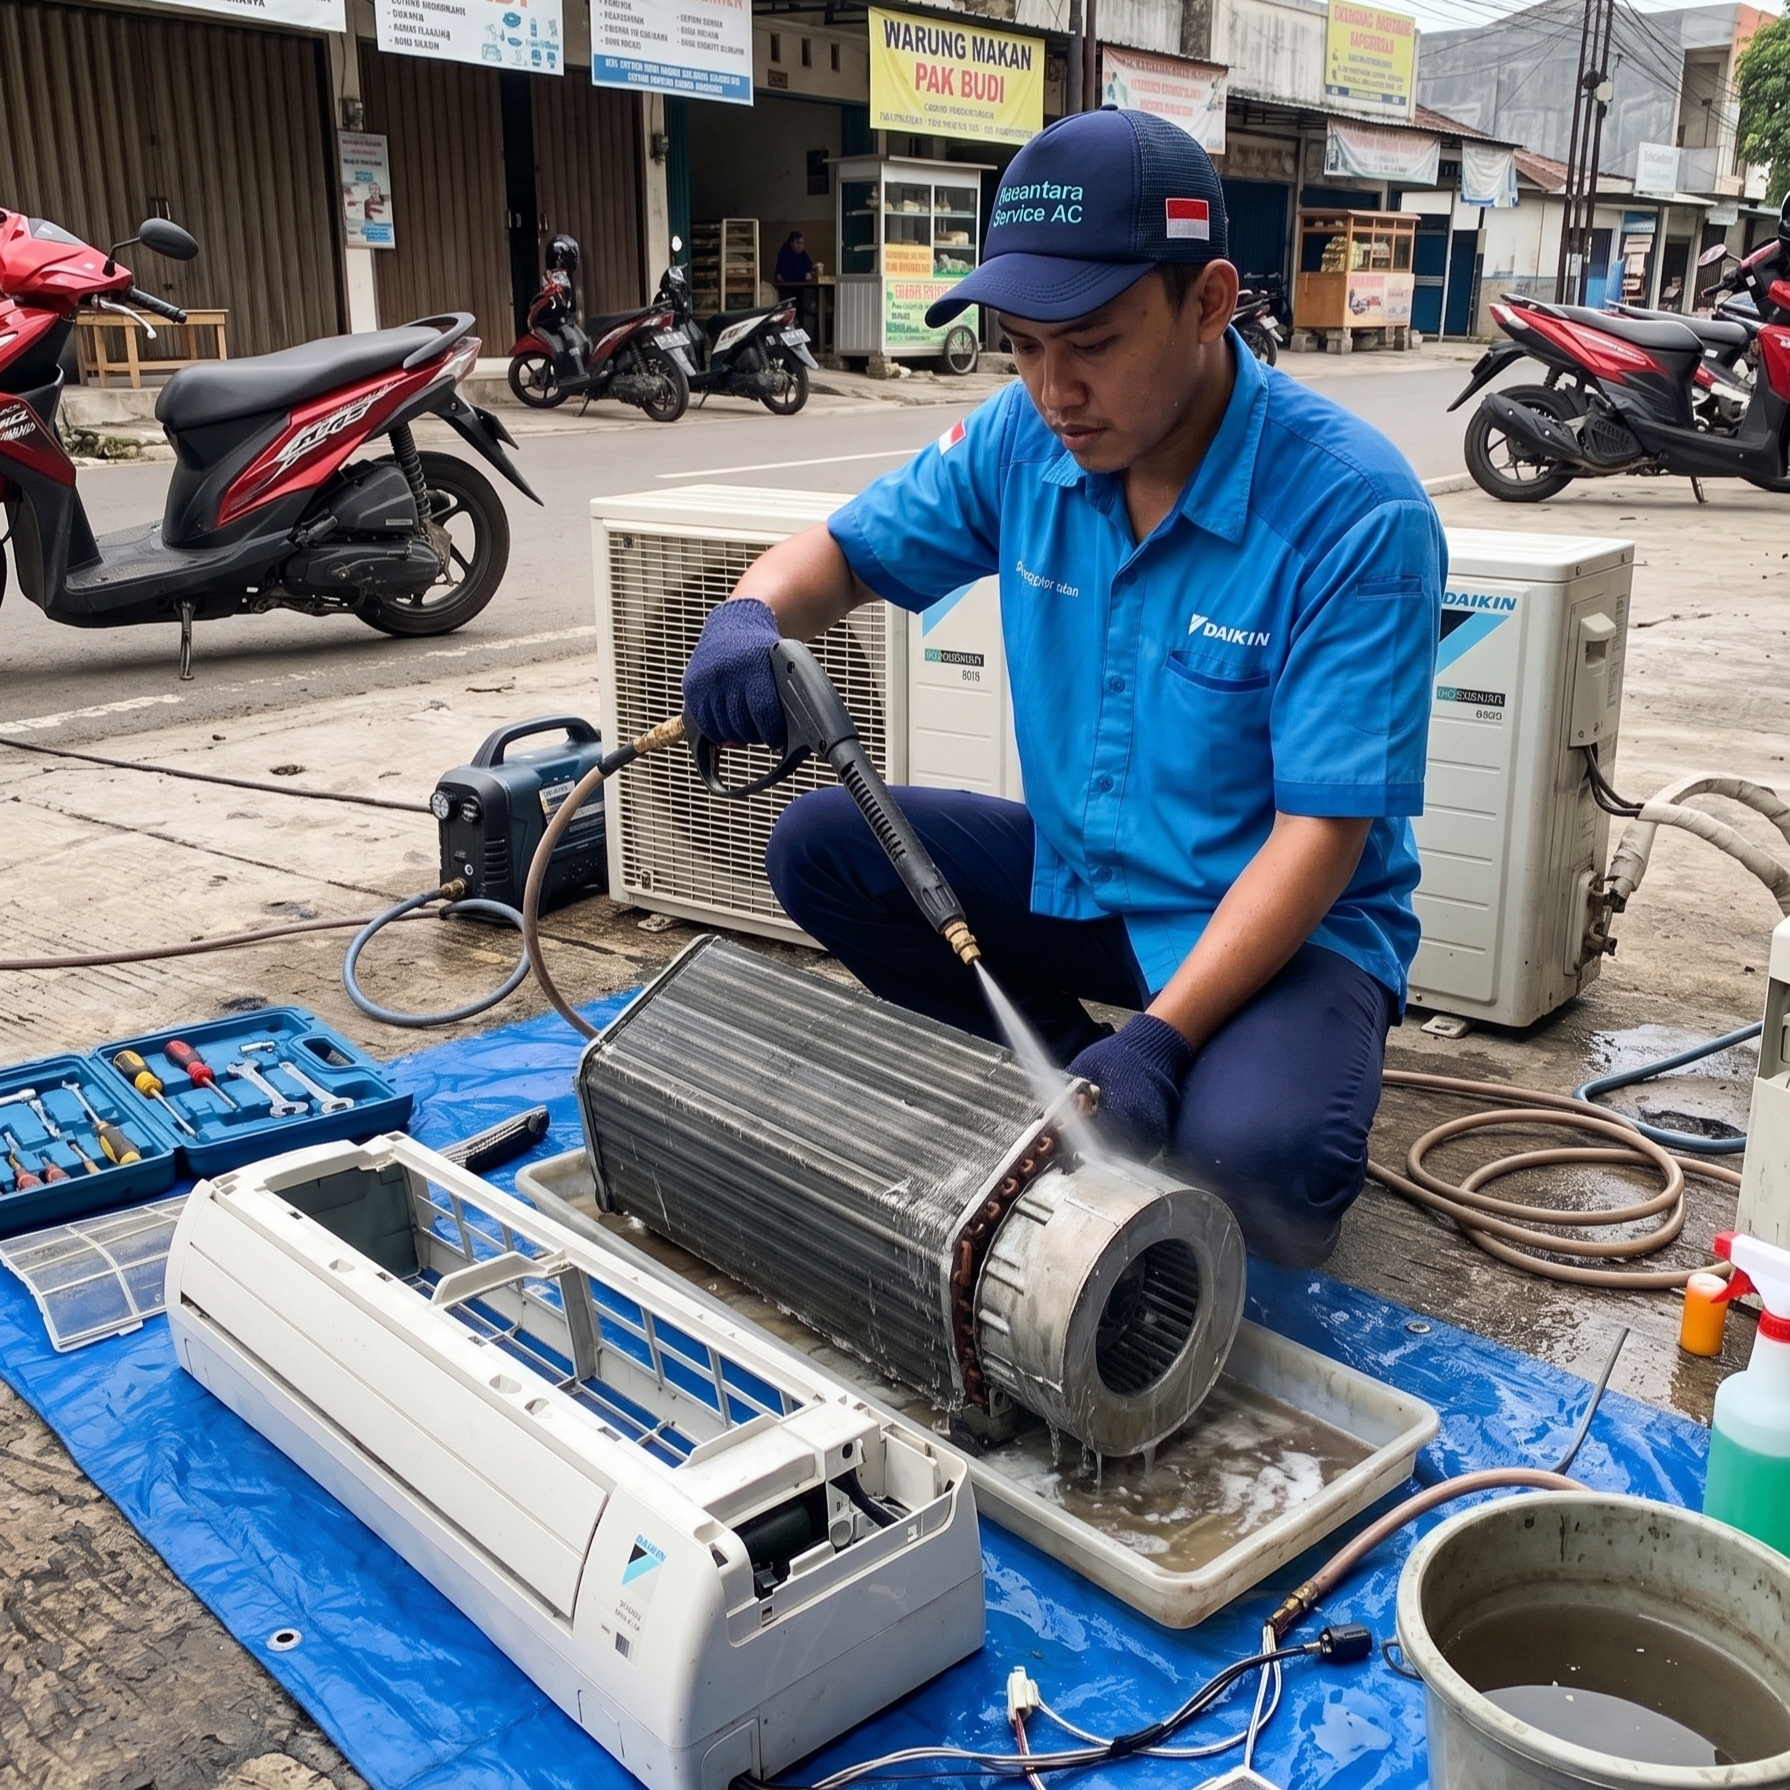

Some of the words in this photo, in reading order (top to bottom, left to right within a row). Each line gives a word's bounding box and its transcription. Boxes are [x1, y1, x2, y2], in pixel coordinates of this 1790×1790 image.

[884, 19, 966, 60] WARUNG
[972, 35, 1031, 71] MAKAN
[915, 62, 954, 96] PAK
[960, 69, 1004, 104] BUDI
[993, 204, 1045, 228] Service
[1050, 204, 1083, 224] AC
[1442, 592, 1517, 611] DAIKIN
[1203, 622, 1271, 647] DAIKIN
